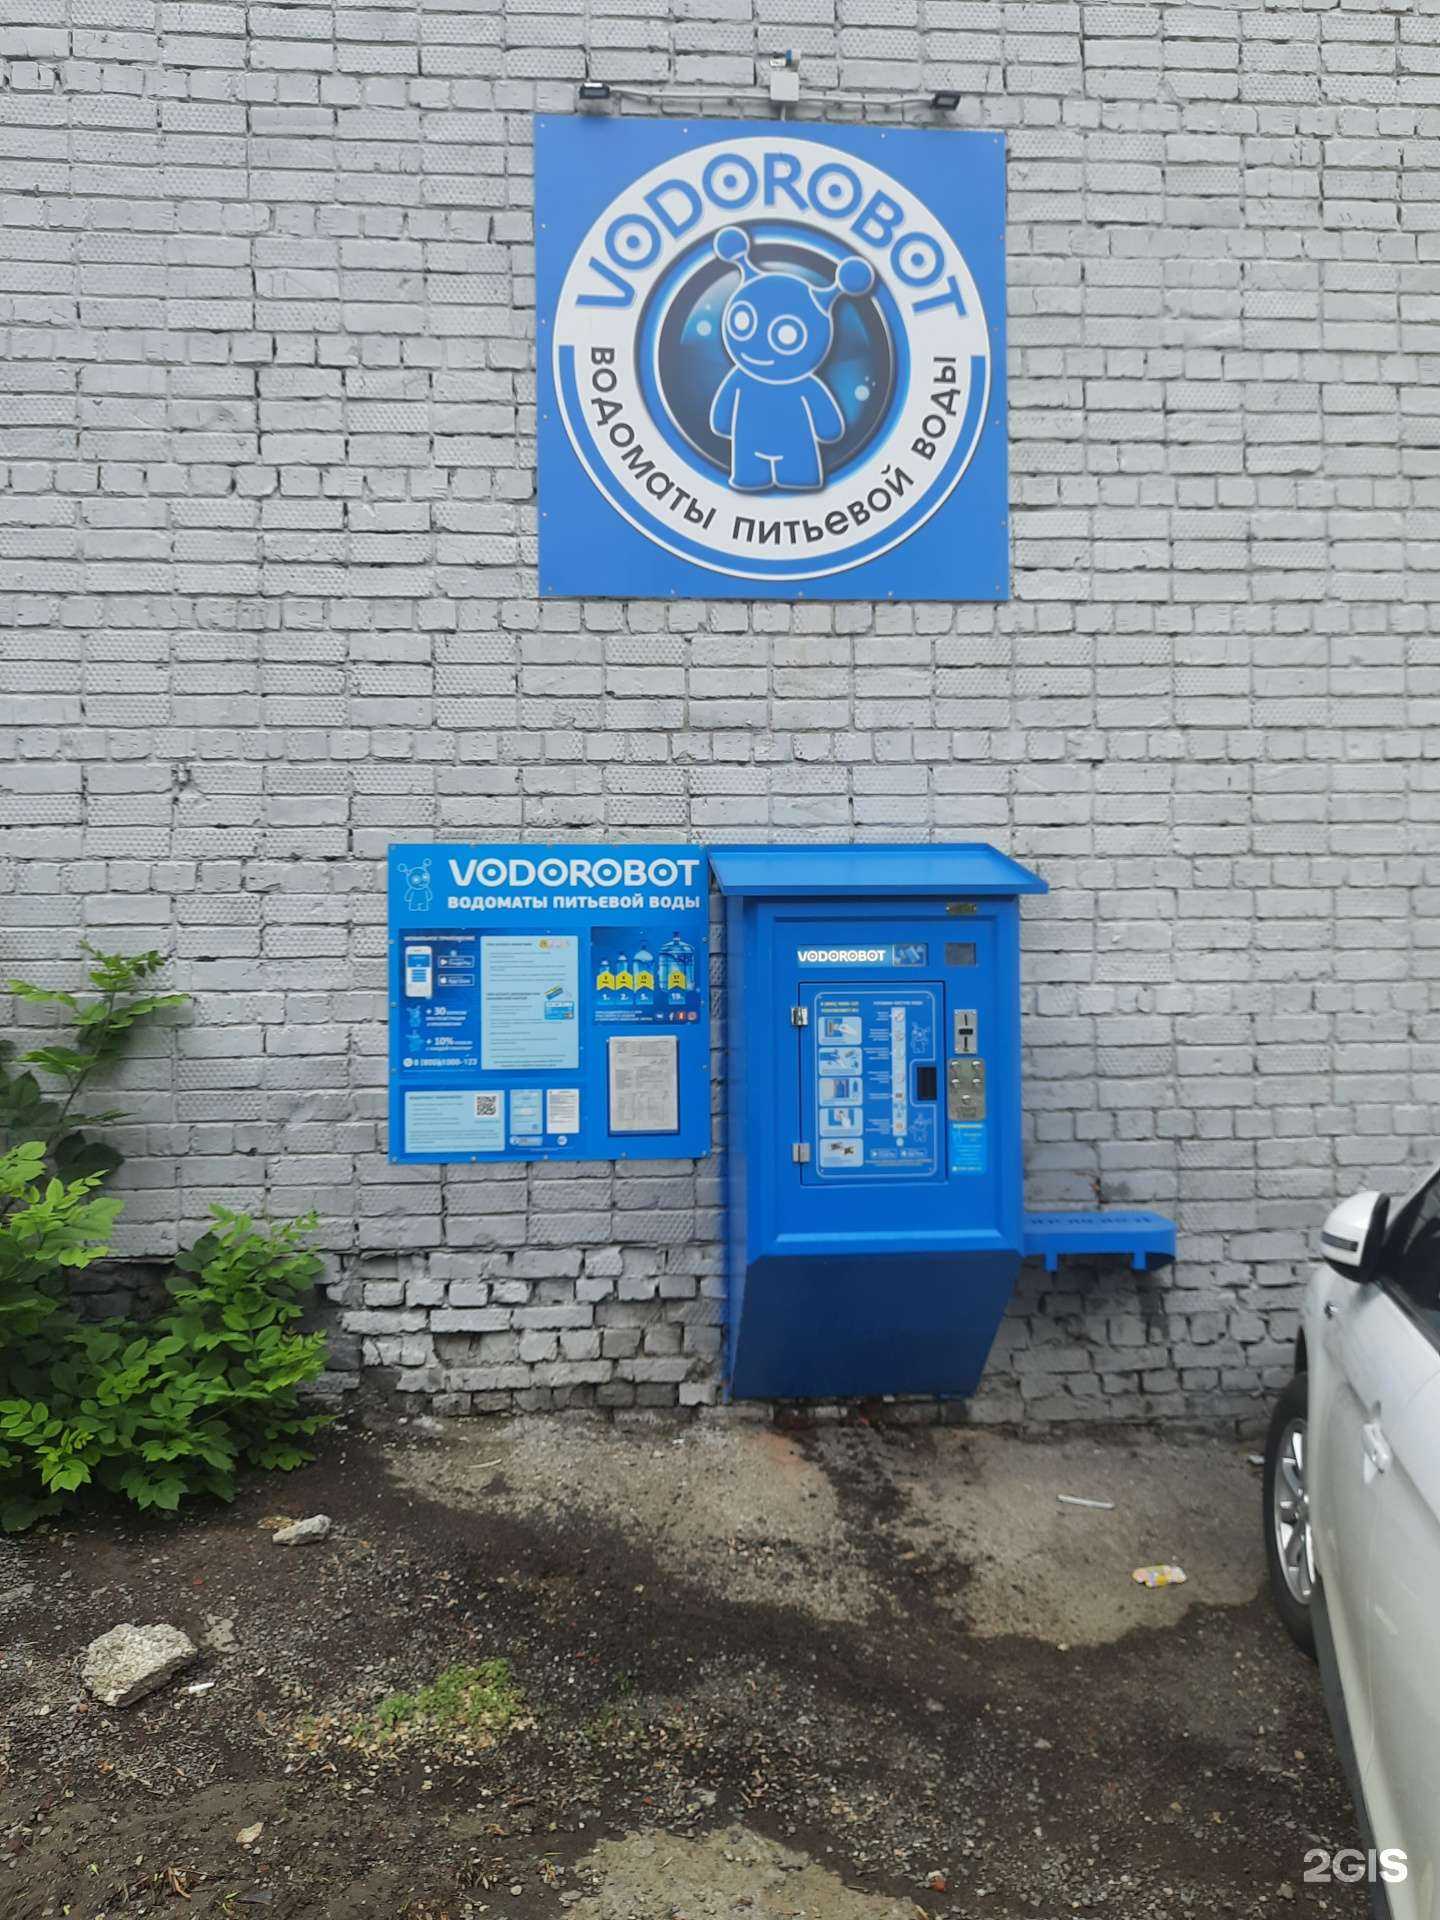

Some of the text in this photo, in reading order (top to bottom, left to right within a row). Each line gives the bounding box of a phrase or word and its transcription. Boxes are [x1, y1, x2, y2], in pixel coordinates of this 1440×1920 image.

[575, 152, 968, 320] VODOROBOT
[448, 857, 700, 888] VODOROBOT
[447, 893, 700, 911] ВОДОМАТЫ ПИТЬЕВОЙ ВОДЫ
[797, 950, 887, 962] VODOROBOT
